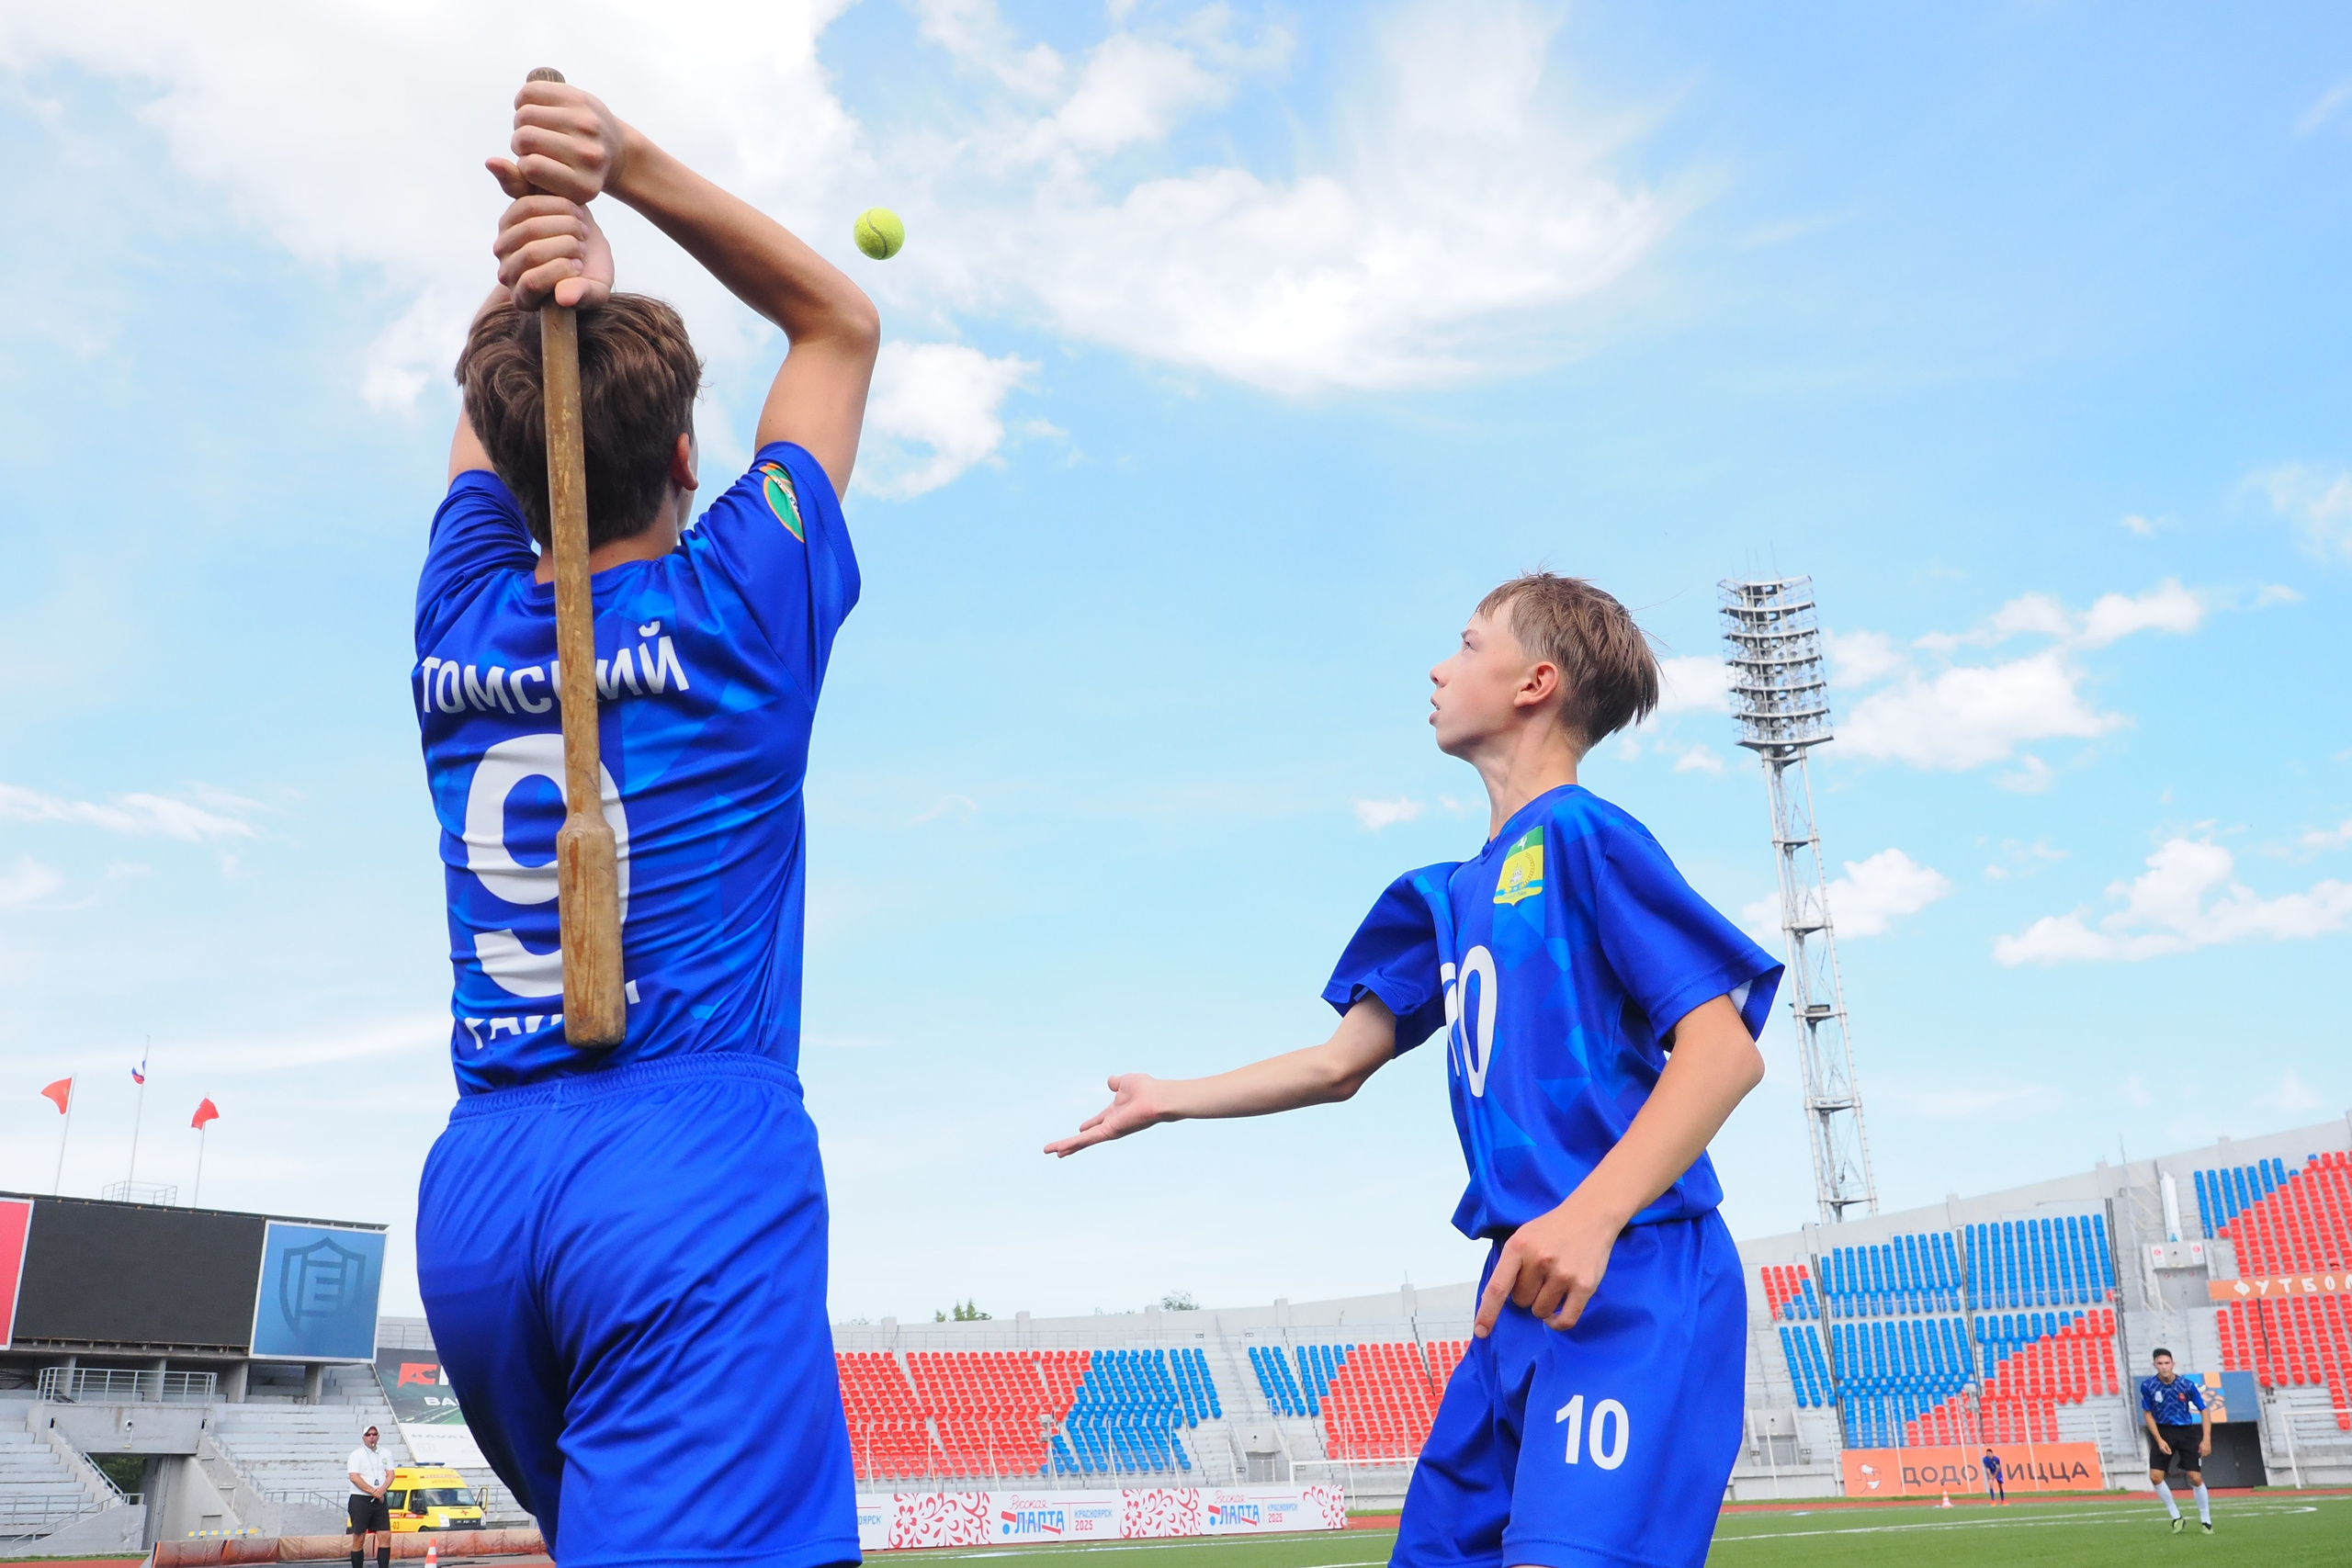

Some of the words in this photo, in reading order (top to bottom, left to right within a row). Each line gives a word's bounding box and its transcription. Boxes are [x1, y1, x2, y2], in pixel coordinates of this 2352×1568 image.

[462, 733, 630, 998] 9
[1555, 1394, 1629, 1470] 10
[1901, 1463, 1979, 1487] ДОДО
[2007, 1461, 2089, 1483] ИЦЦА
[1009, 1494, 1048, 1510] Русская
[1014, 1510, 1065, 1534] ЛАПТА
[1073, 1508, 1113, 1518] КРАСНОЯРСК
[1219, 1504, 1261, 1525] ЛАПТА
[1268, 1513, 1283, 1523] 2025
[1075, 1519, 1093, 1531] 2025
